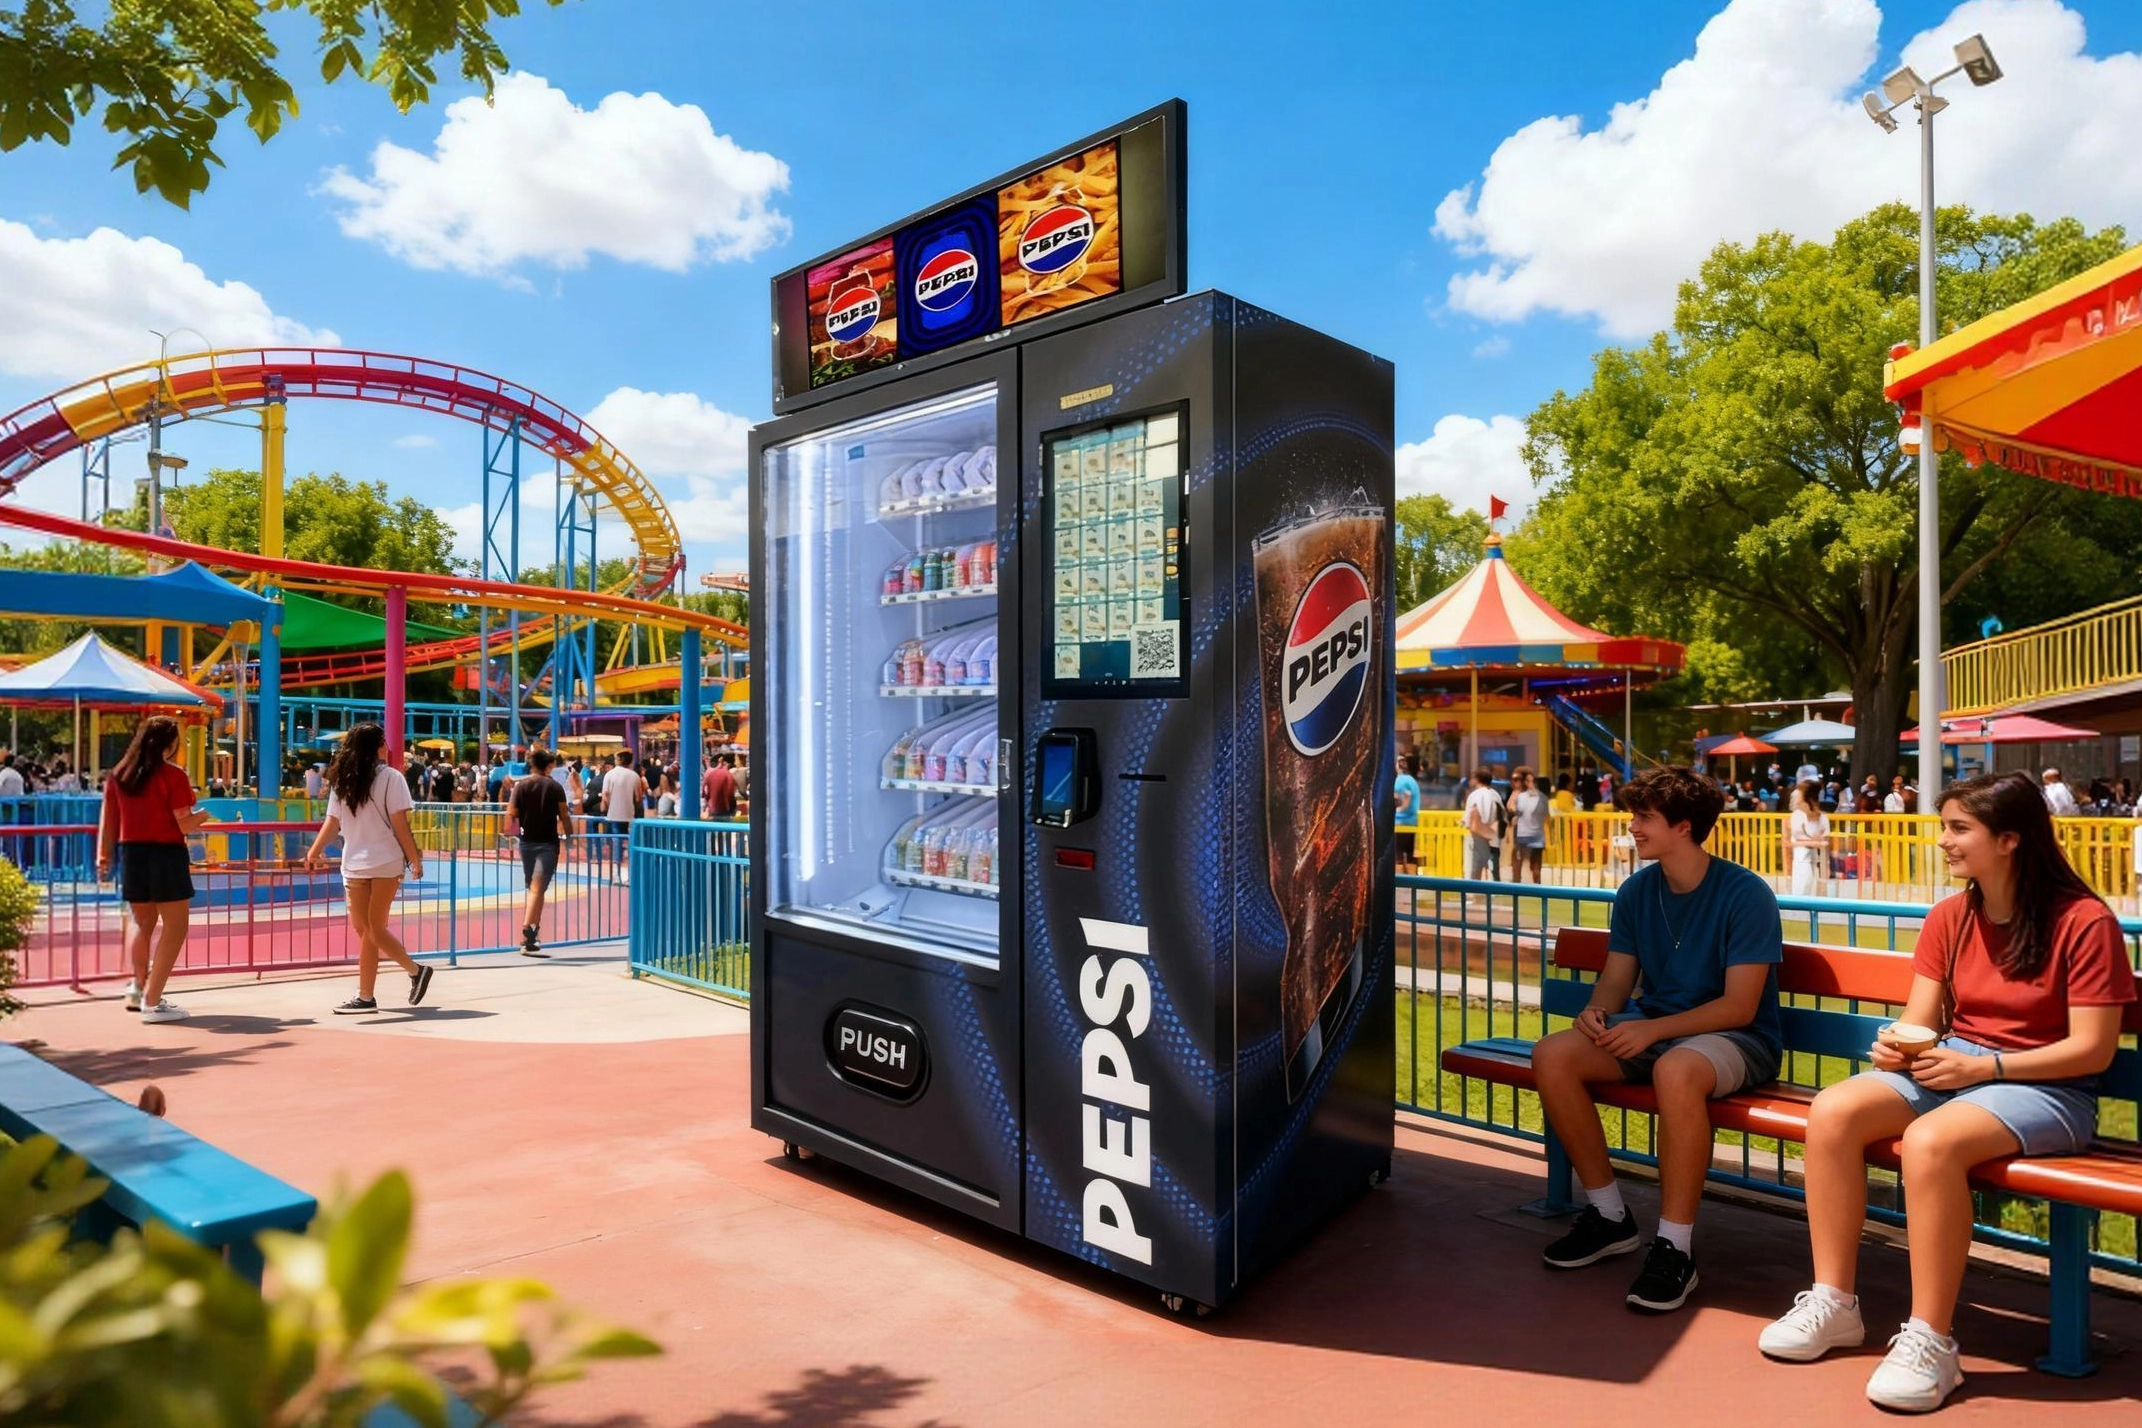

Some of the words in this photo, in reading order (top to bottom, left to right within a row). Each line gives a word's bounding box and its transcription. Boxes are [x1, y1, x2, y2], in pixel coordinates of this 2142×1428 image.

[1022, 222, 1090, 258] PEPSI
[1289, 615, 1369, 705] PEPSI
[840, 1026, 907, 1070] PUSH
[1079, 917, 1152, 1266] PEPSI
